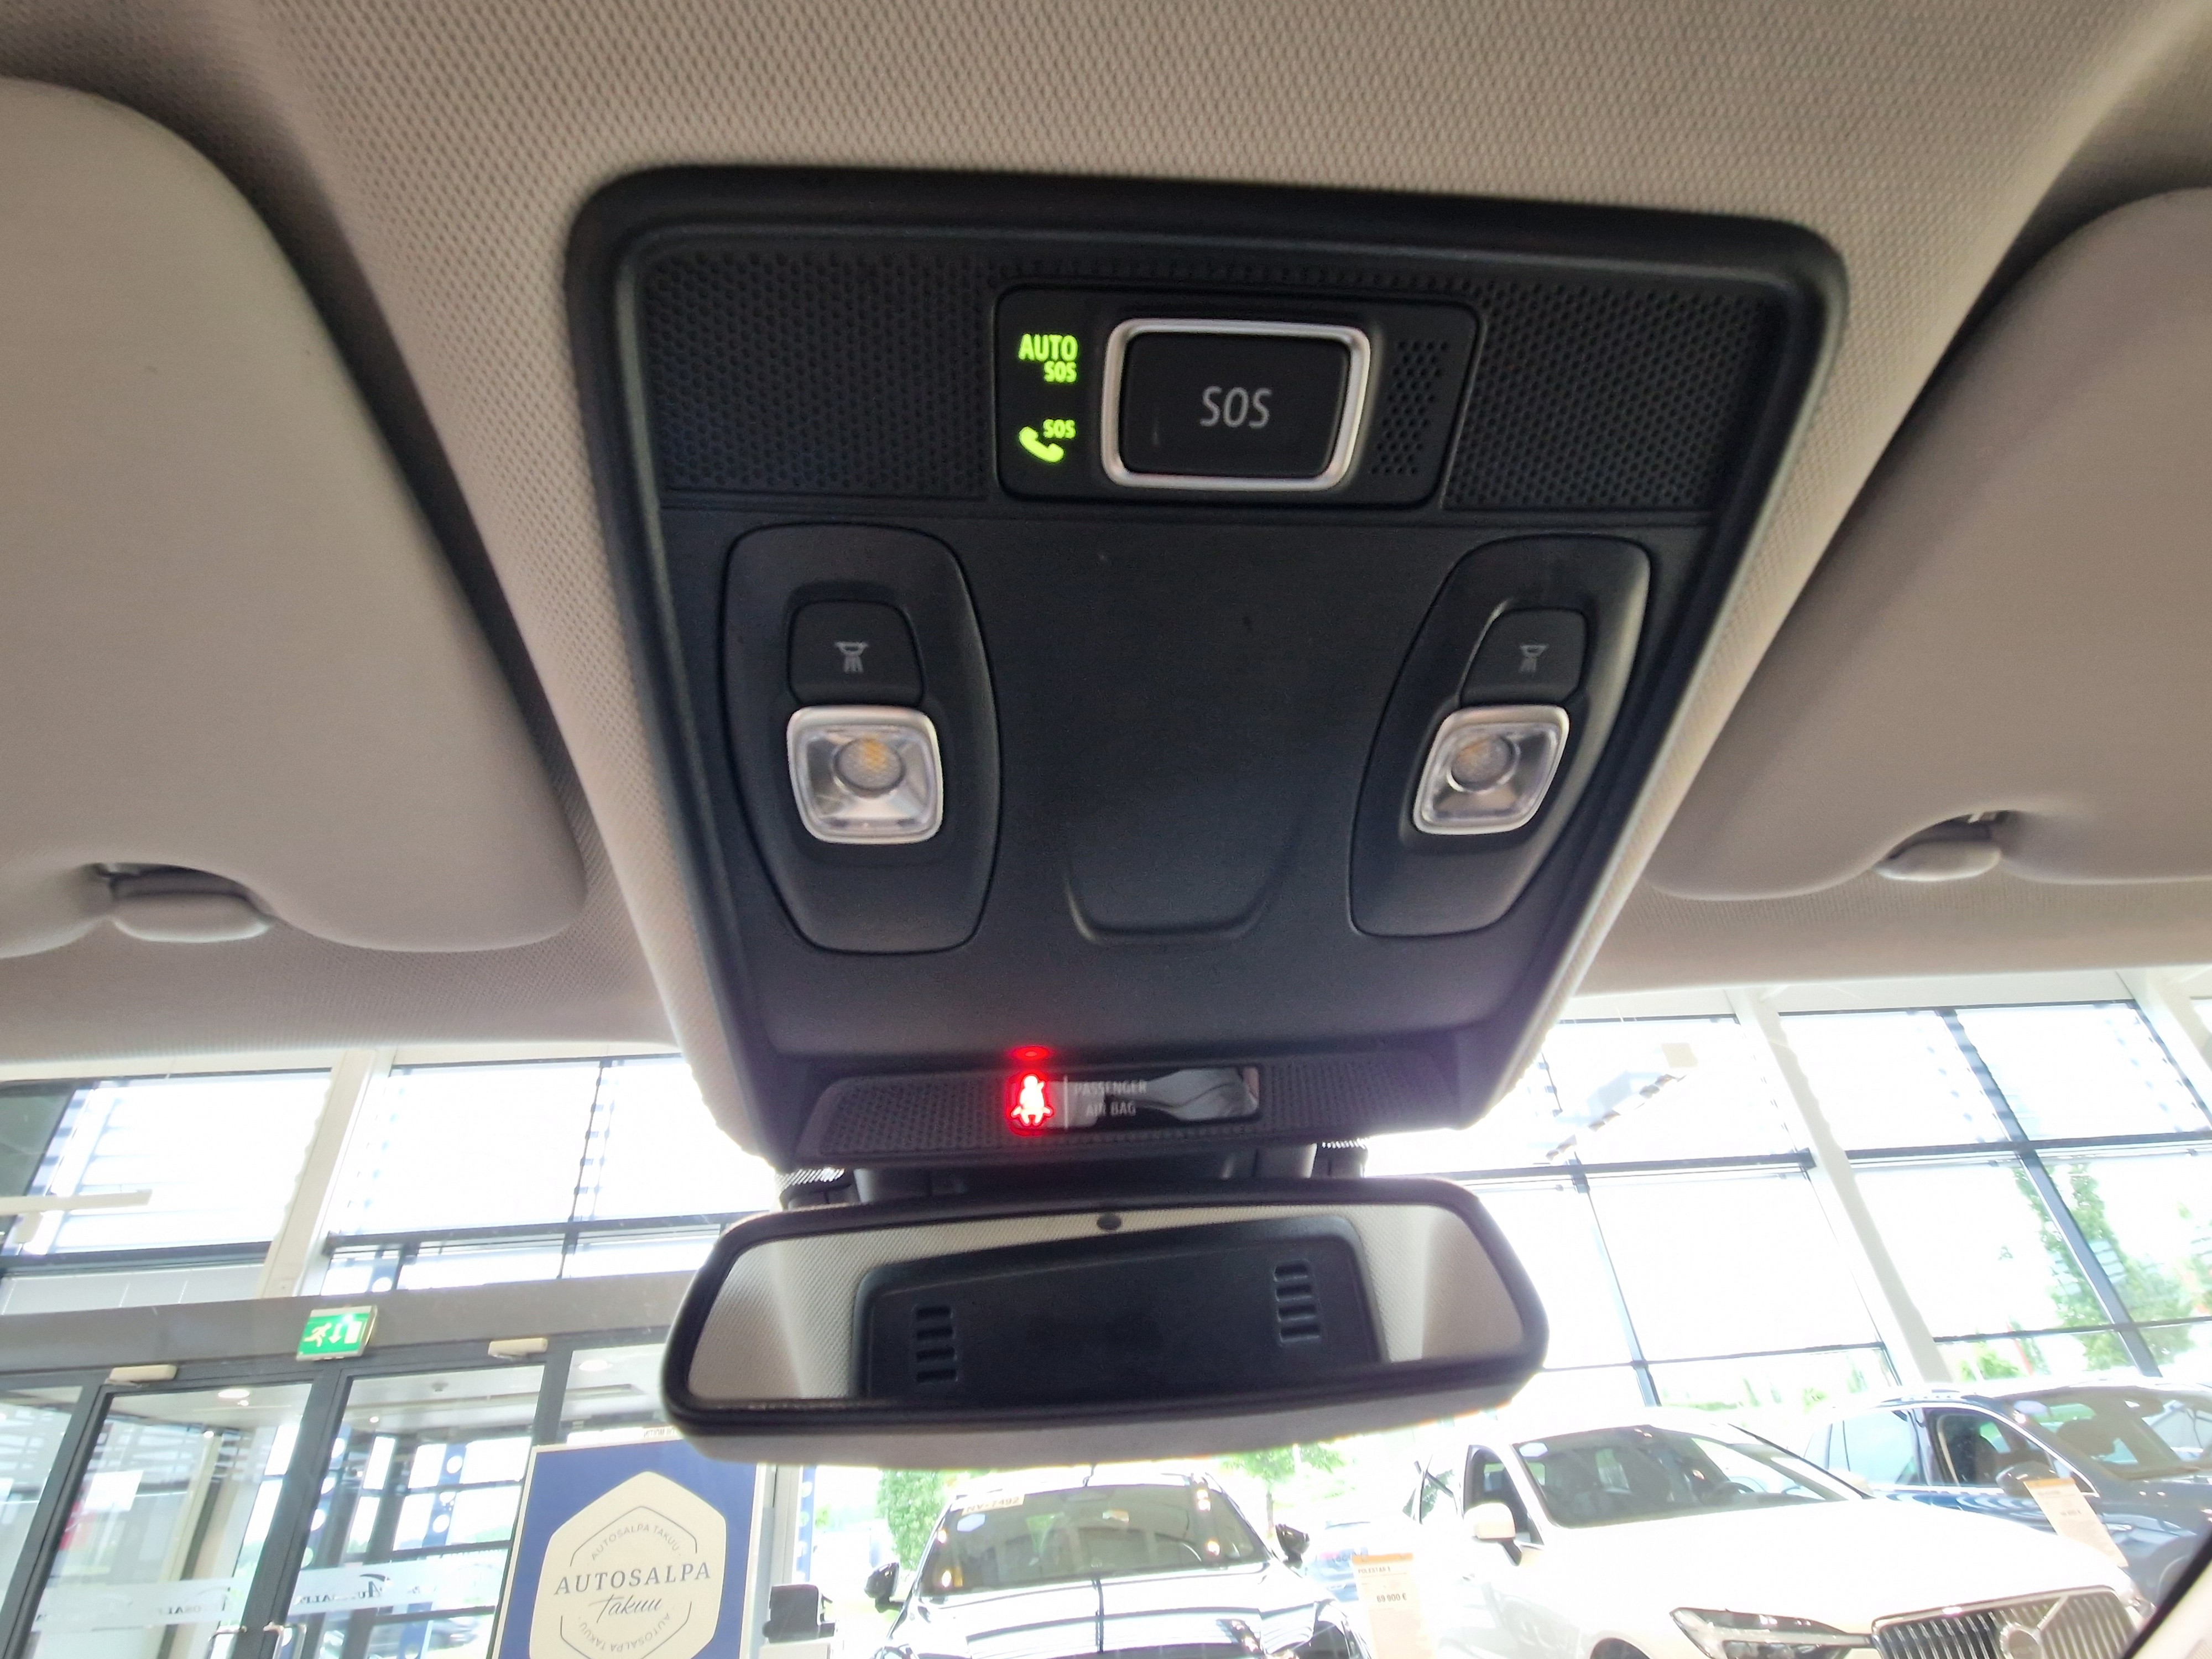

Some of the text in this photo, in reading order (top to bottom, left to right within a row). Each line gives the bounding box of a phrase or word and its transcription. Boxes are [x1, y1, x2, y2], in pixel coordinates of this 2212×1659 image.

[1018, 333, 1078, 361] AUTO
[1044, 360, 1077, 383] SOS
[1199, 386, 1273, 429] SOS
[1042, 419, 1076, 440] SOS
[1074, 1080, 1147, 1096] PASSENGER
[1086, 1101, 1136, 1117] AIR BAG
[591, 1524, 680, 1561] AUTOSALPA TAKUU
[553, 1562, 711, 1595] AUTOSALPA
[579, 1612, 670, 1652] AUTOSALPA TAKUU
